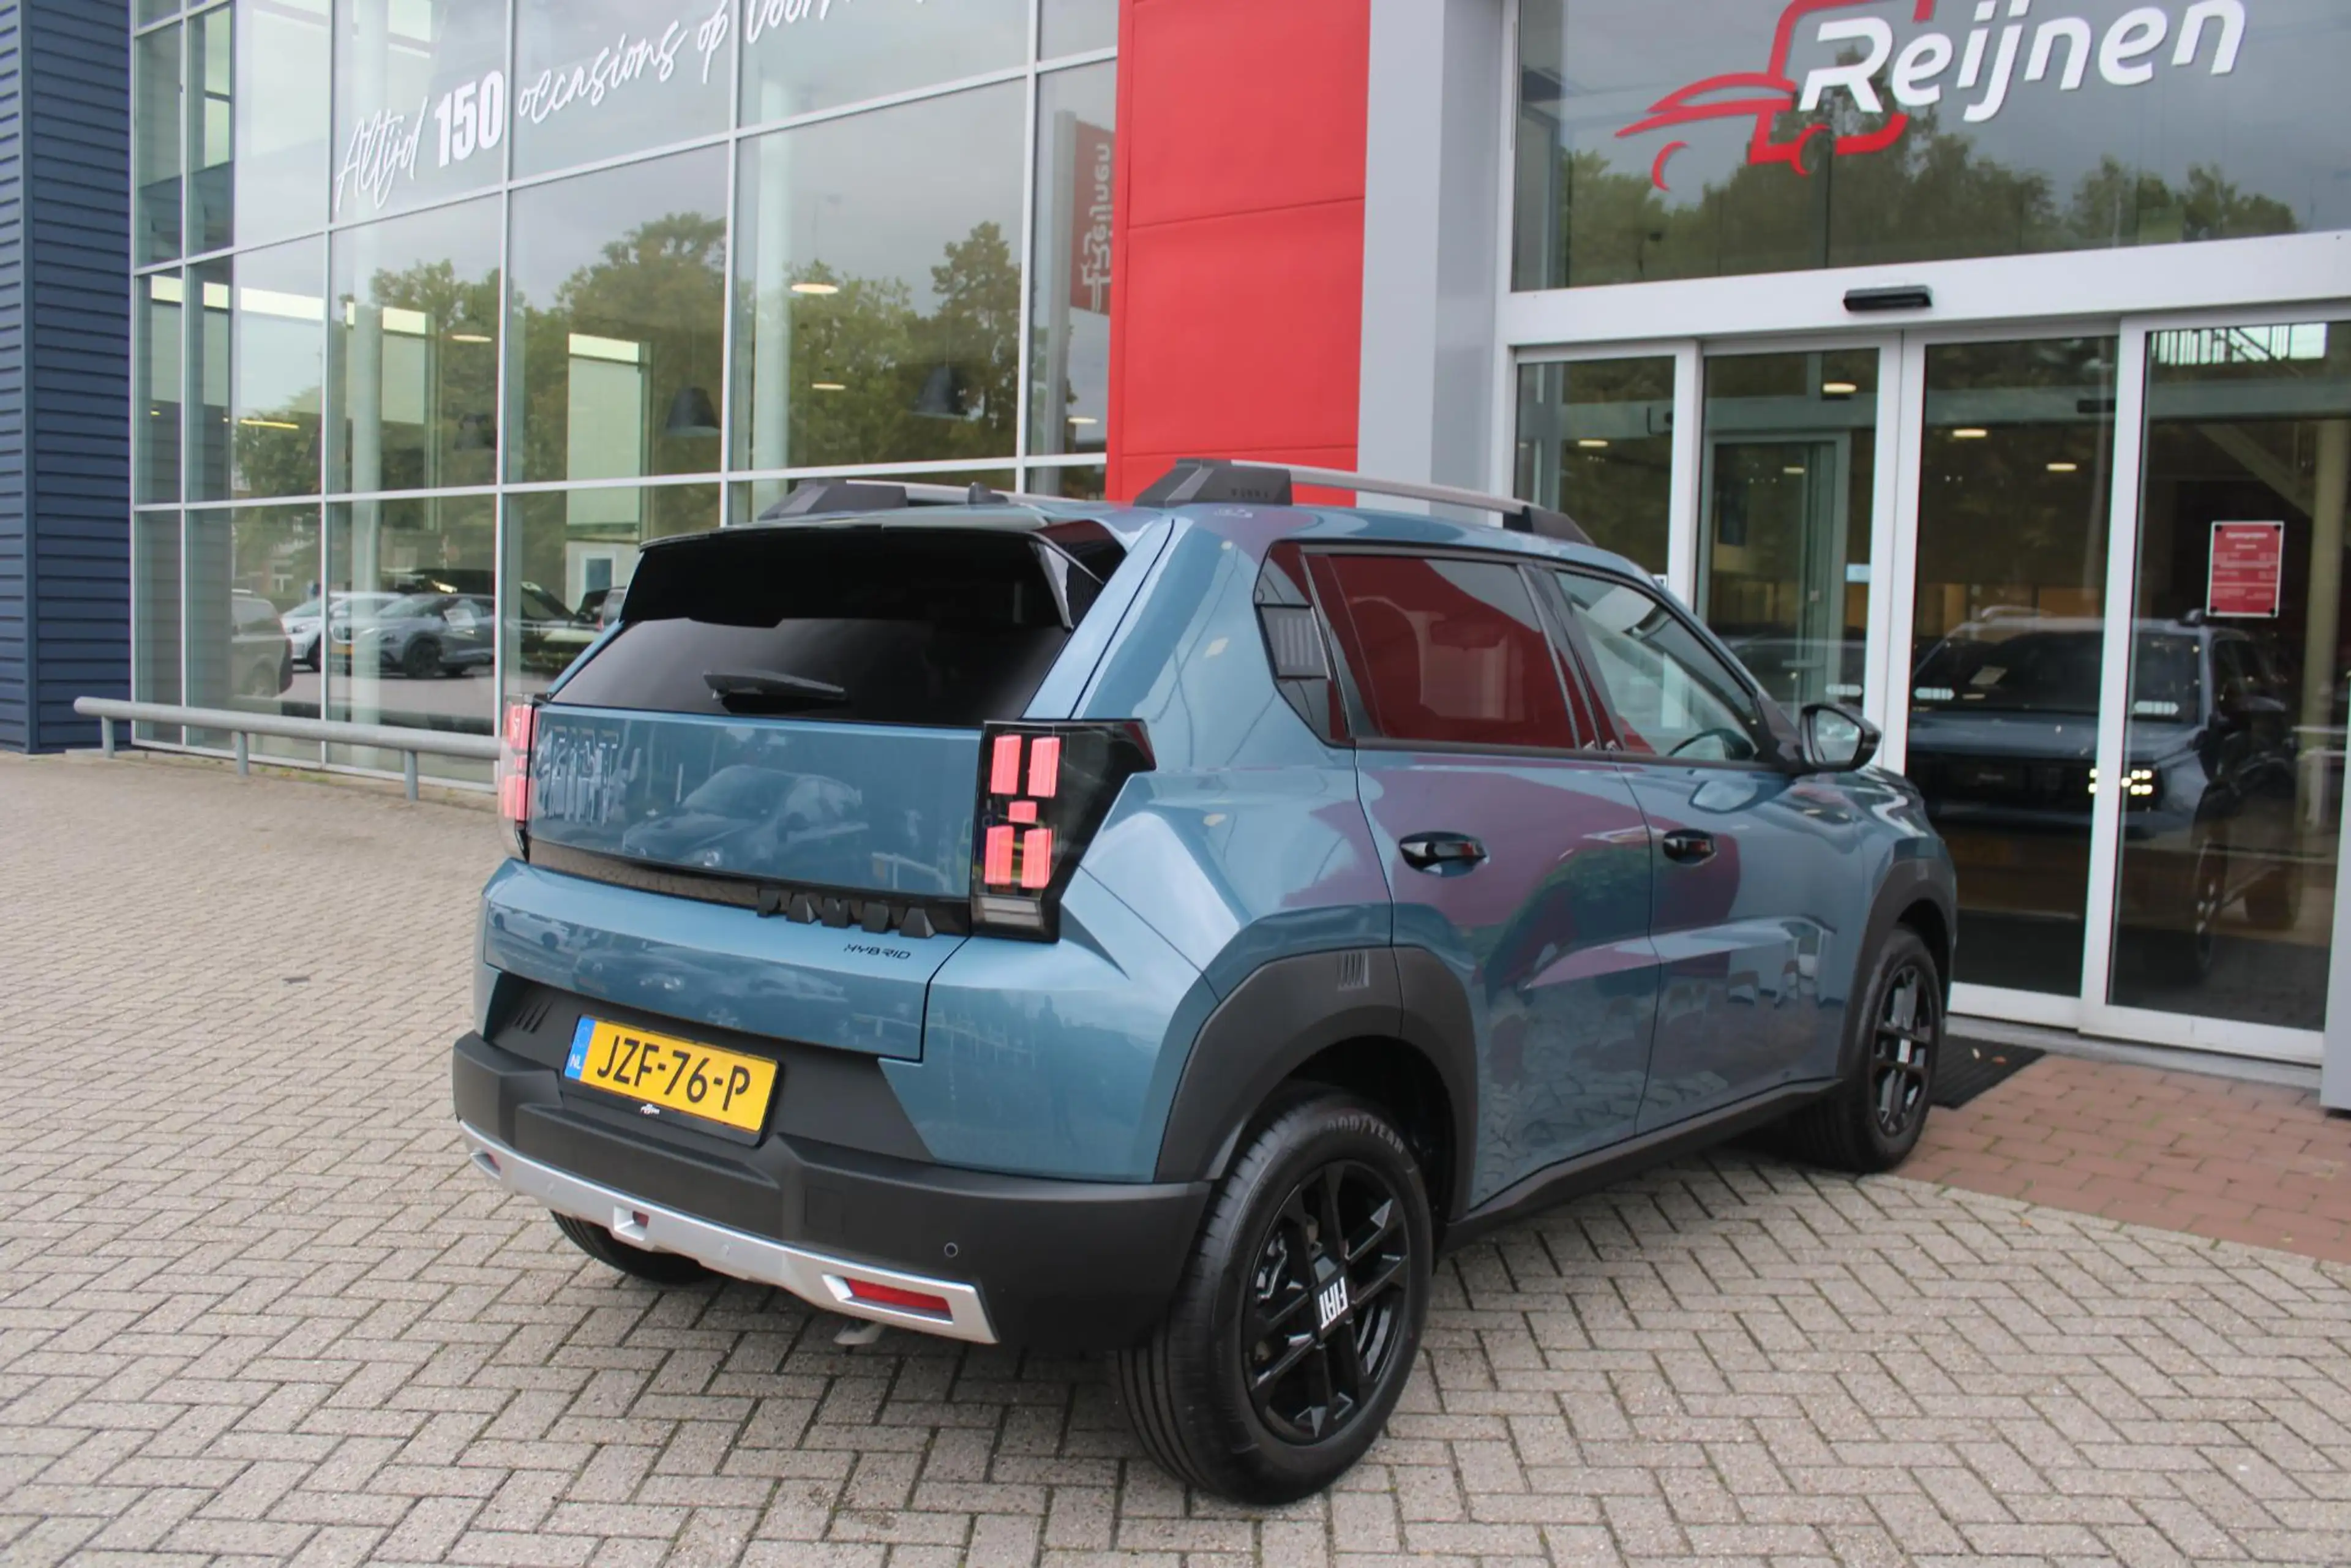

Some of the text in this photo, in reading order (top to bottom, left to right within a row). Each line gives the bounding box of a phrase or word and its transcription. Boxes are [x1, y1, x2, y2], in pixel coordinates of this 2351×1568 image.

[1799, 0, 2246, 122] Reijnen
[336, 96, 429, 212] Altijd
[434, 70, 504, 168] 150
[518, 20, 689, 124] occasions
[697, 0, 729, 84] op
[757, 888, 936, 939] PANDA
[843, 943, 911, 959] HYBRID
[568, 1053, 582, 1070] NL
[596, 1035, 751, 1111] JZF-76-P
[1319, 1276, 1348, 1330] FIAT
